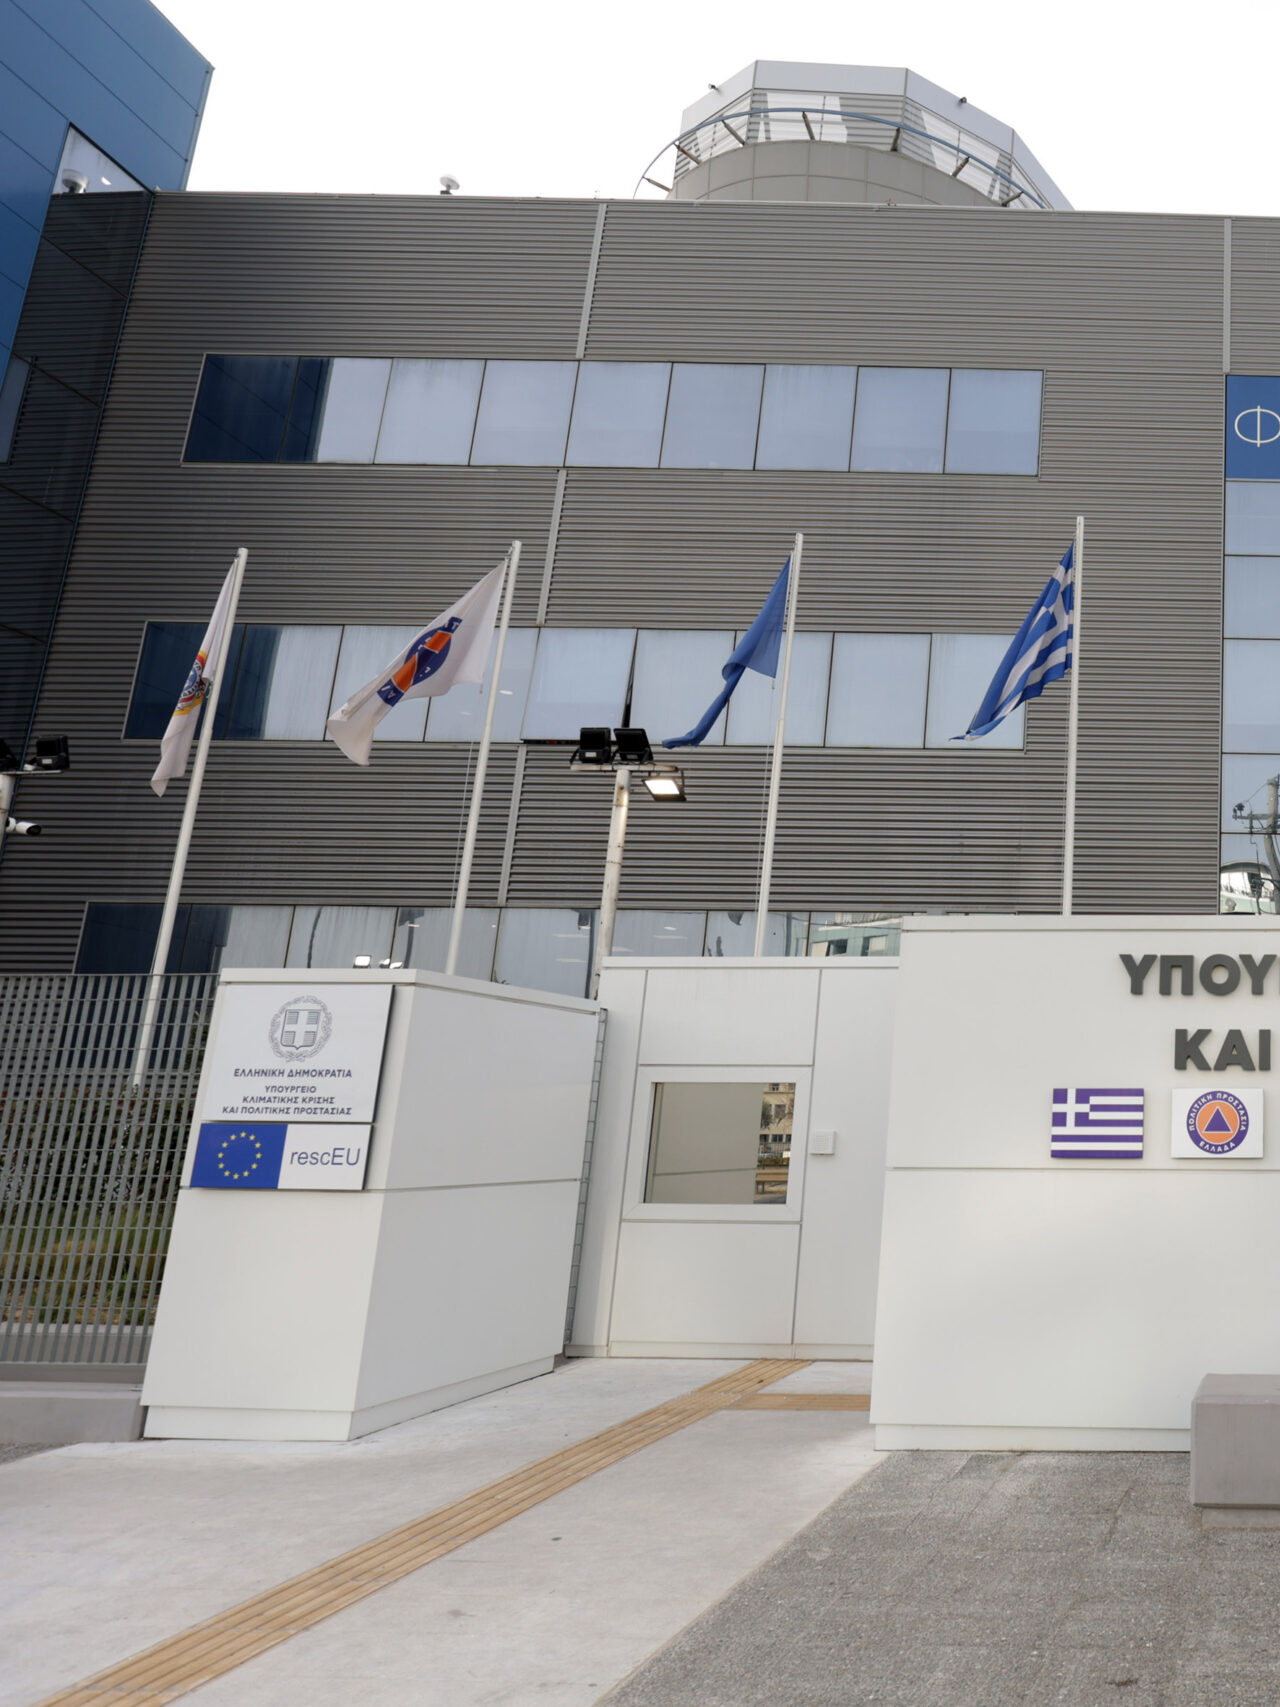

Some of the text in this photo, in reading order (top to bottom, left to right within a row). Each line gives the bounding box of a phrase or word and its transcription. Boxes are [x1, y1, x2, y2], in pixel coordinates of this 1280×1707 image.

[1174, 1028, 1272, 1072] ΚΑΙ
[233, 1068, 352, 1079] ΕΛΛΗΝΙΚΗ ΔΗΜΟΚΡΑΤΙΑ
[264, 1085, 317, 1094] ΥΠΟΥΡΓΕΙΟ
[242, 1096, 335, 1105] ΚΛΙΜΑΤΙΚΗΣ ΚΡΙΣΗΣ
[222, 1106, 352, 1116] ΚΑΙ ΠΟΛΙΤΙΚΗΣ ΠΡΟΣΤΑΣΙΑΣ
[1189, 1092, 1247, 1131] ΠΟΛΙΤΙΚΗ ΠΡΟΣΤΑΣΙΑ
[1198, 1140, 1236, 1152] ΕΛΛΑΔΑ
[290, 1147, 361, 1166] rescEU
